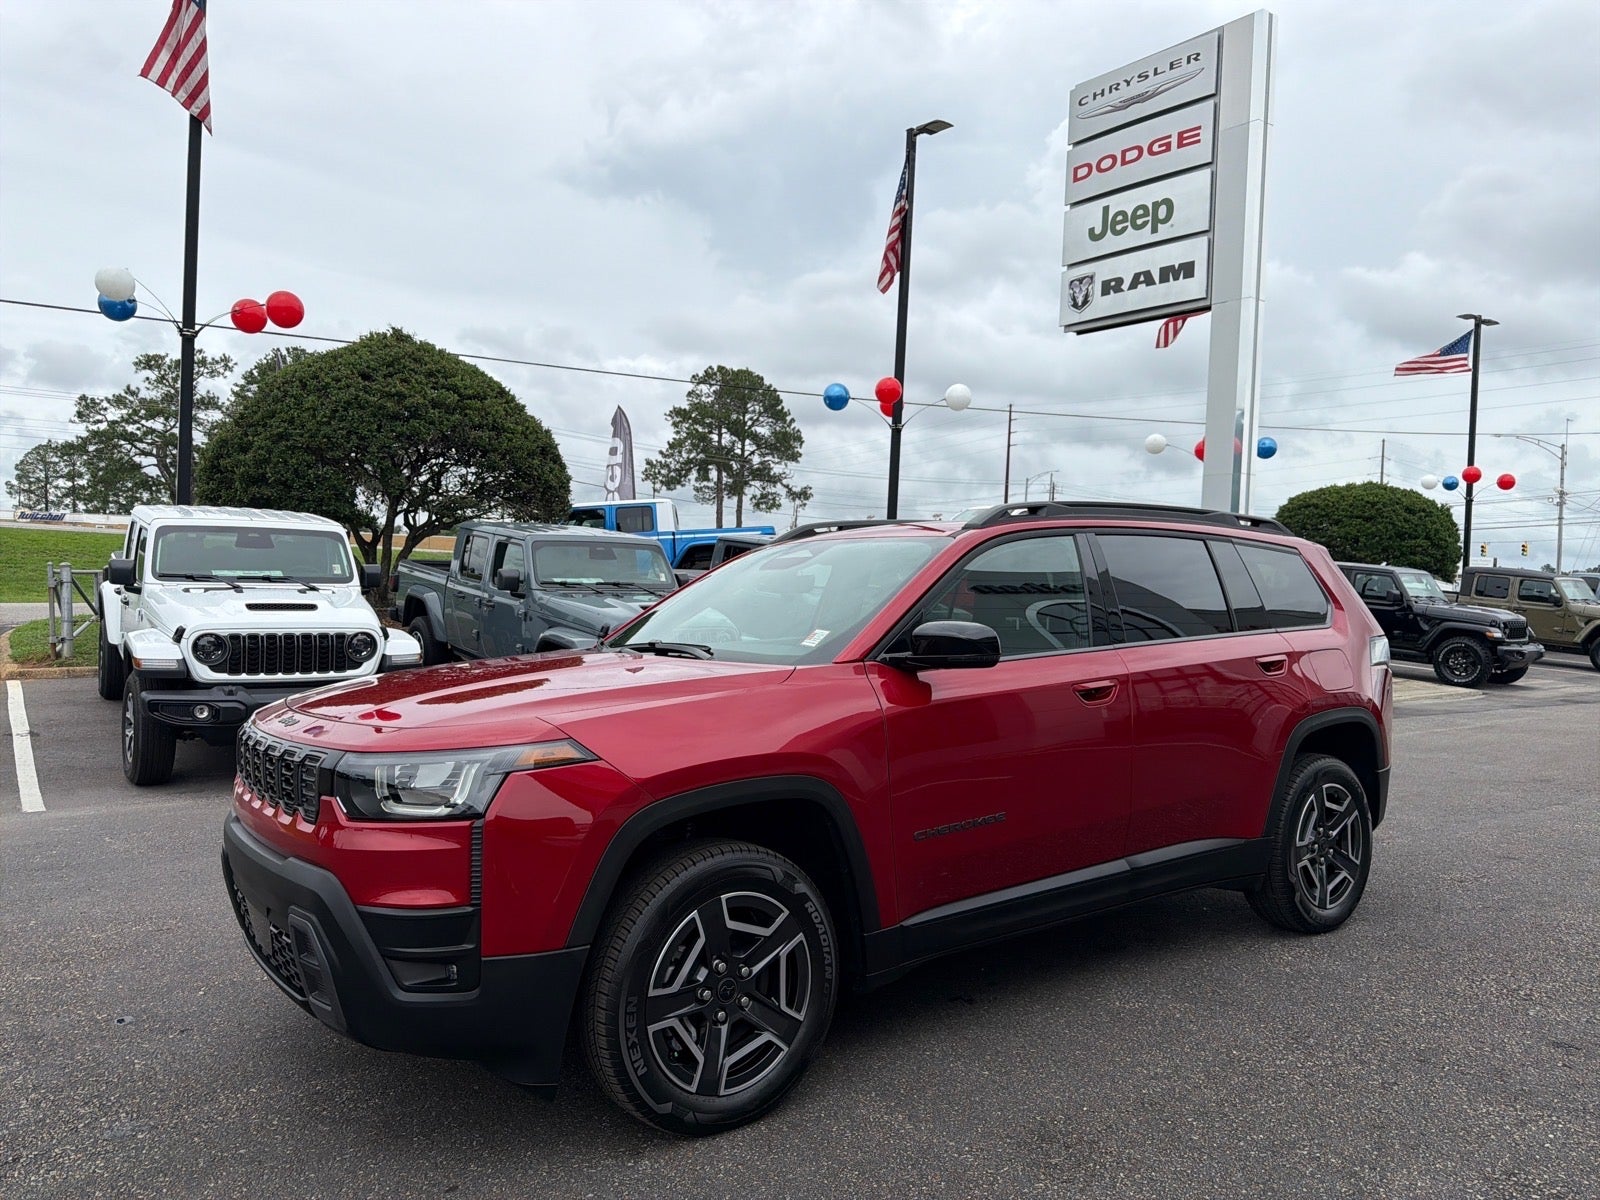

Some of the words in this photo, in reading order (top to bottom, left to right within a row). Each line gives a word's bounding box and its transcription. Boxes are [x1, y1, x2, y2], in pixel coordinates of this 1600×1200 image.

[1078, 52, 1201, 107] CHRYSLER
[1072, 125, 1202, 184] DODGE
[1088, 197, 1174, 242] Jeep
[1100, 260, 1195, 297] RAM
[913, 811, 1006, 842] CHEROKEE
[804, 901, 833, 980] ROADIAN
[626, 996, 648, 1077] NEXEN
